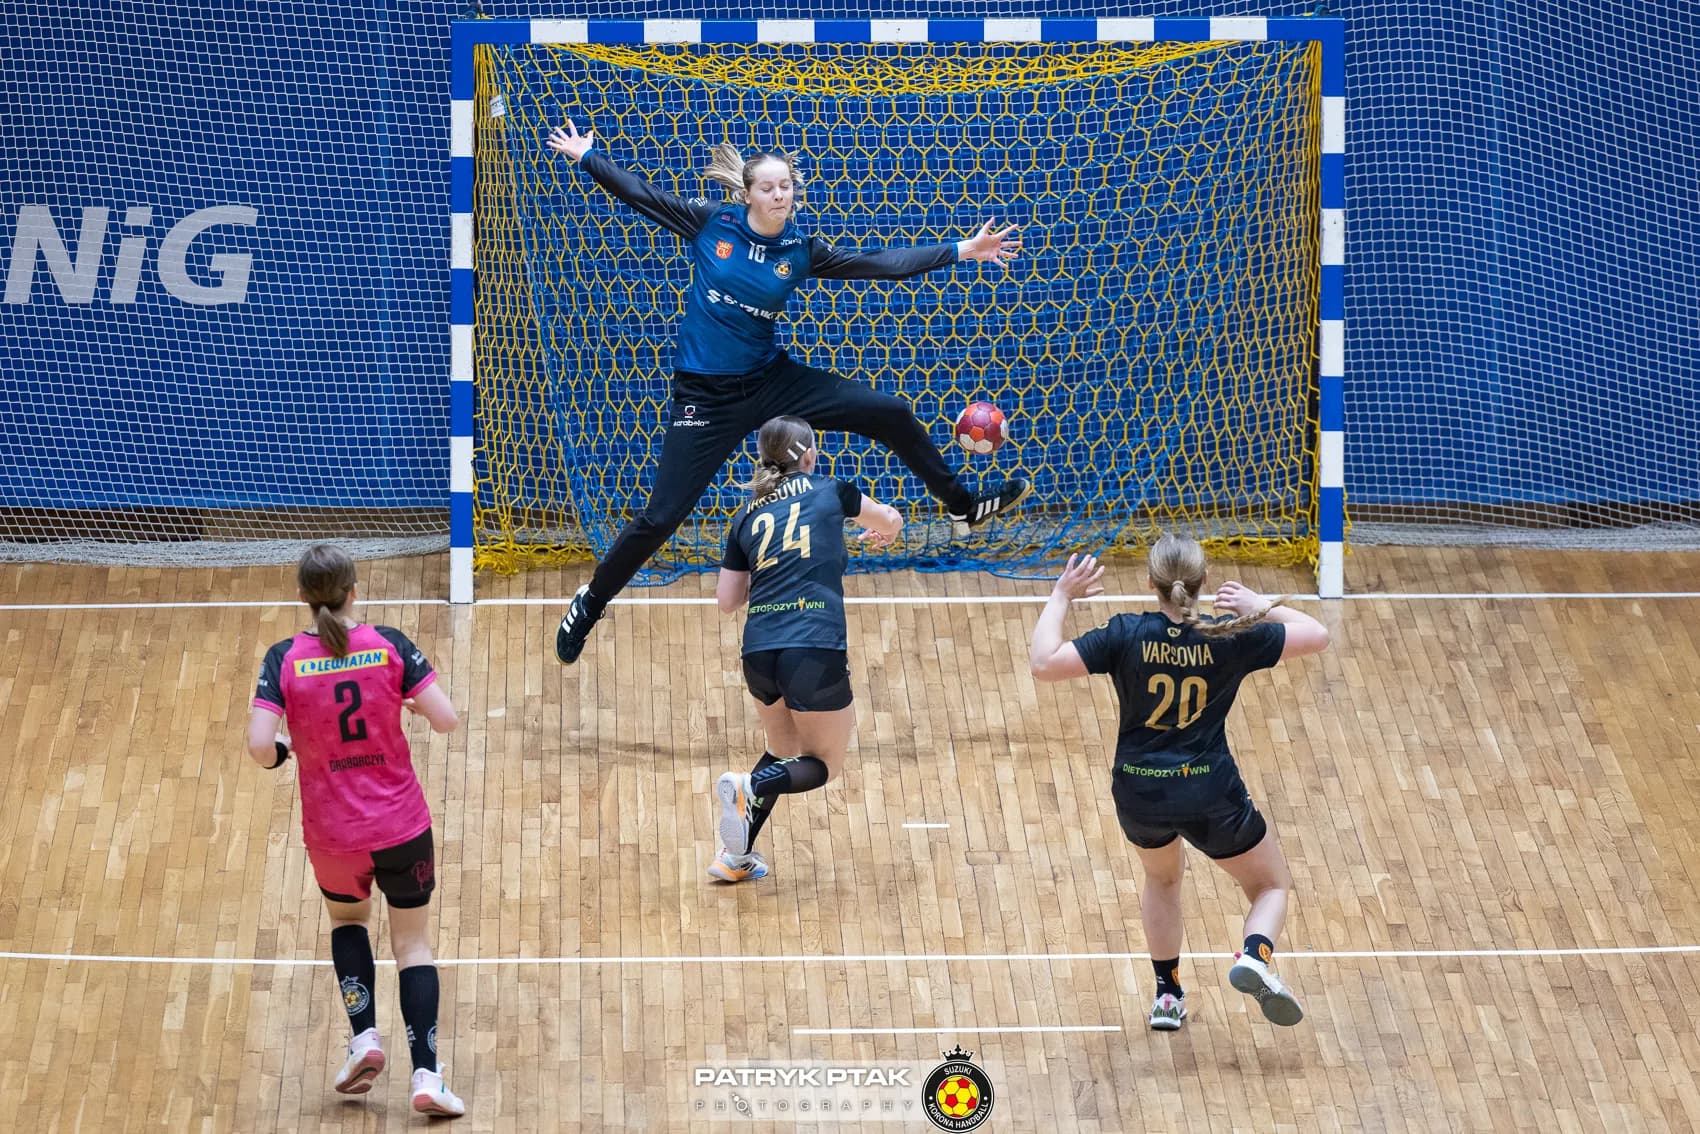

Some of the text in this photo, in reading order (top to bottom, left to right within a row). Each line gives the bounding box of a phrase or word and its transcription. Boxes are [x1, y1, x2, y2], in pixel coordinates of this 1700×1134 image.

[4, 204, 259, 305] NiG
[751, 501, 811, 571] 24
[317, 652, 382, 672] LEWIATAN
[1142, 640, 1214, 667] VARSOVIA
[334, 680, 368, 743] 2
[1144, 673, 1208, 731] 20
